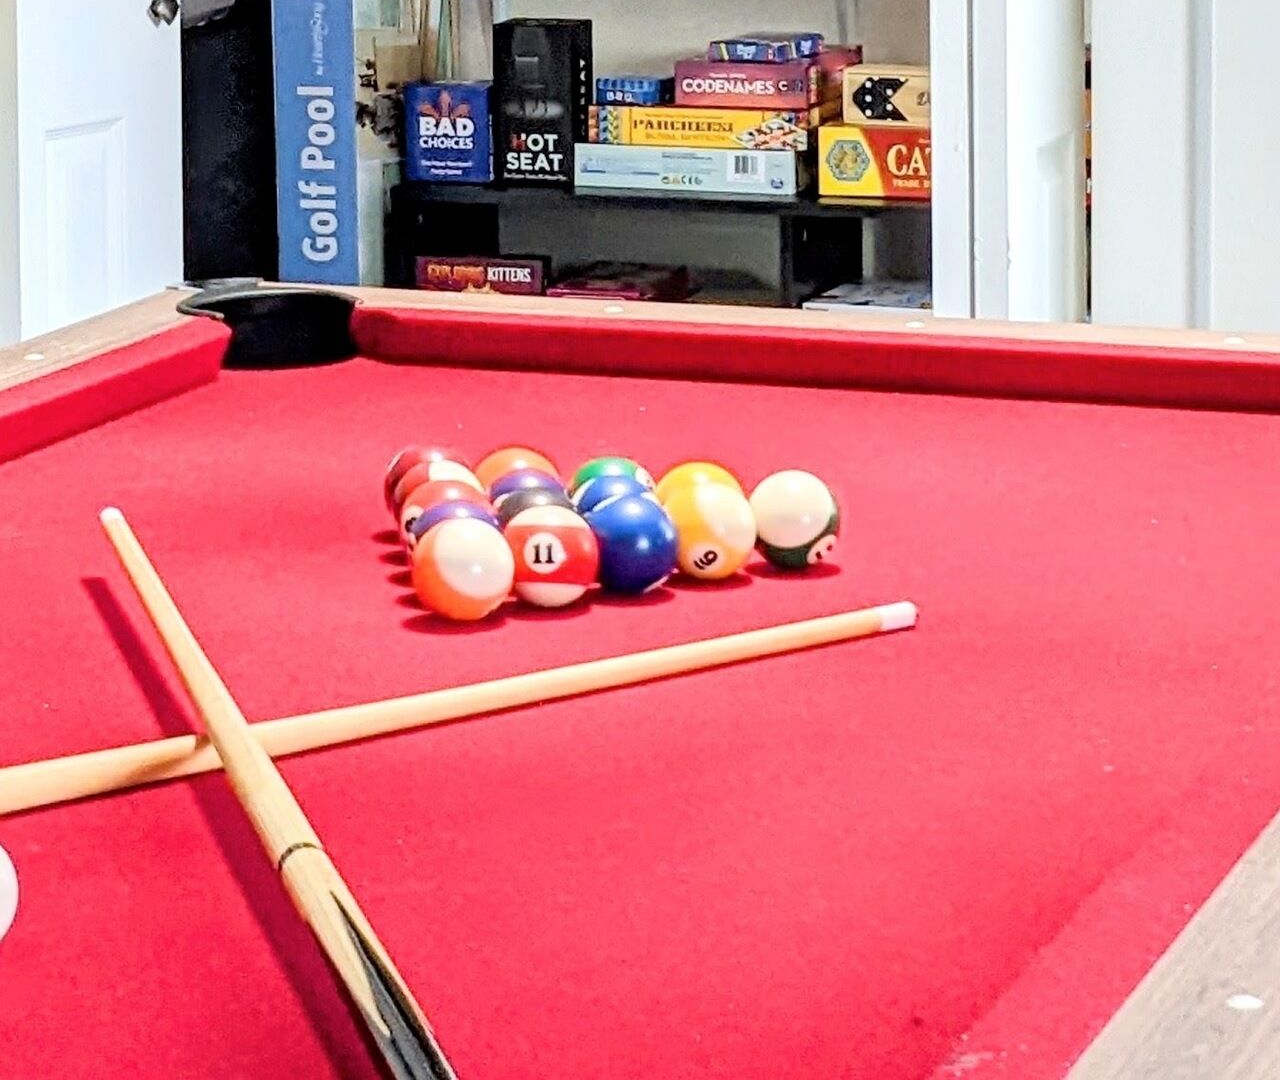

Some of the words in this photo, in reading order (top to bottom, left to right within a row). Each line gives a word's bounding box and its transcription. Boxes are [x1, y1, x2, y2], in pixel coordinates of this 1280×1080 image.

[681, 77, 775, 96] CODENAMES
[296, 86, 336, 171] Pool
[419, 115, 475, 137] BAD
[633, 118, 735, 133] PARCHEESI
[419, 136, 474, 150] CHOICES
[510, 132, 559, 152] HOT
[506, 152, 564, 172] SEAT
[300, 179, 338, 262] Golf
[486, 265, 532, 283] KITTENS
[532, 542, 556, 565] 11
